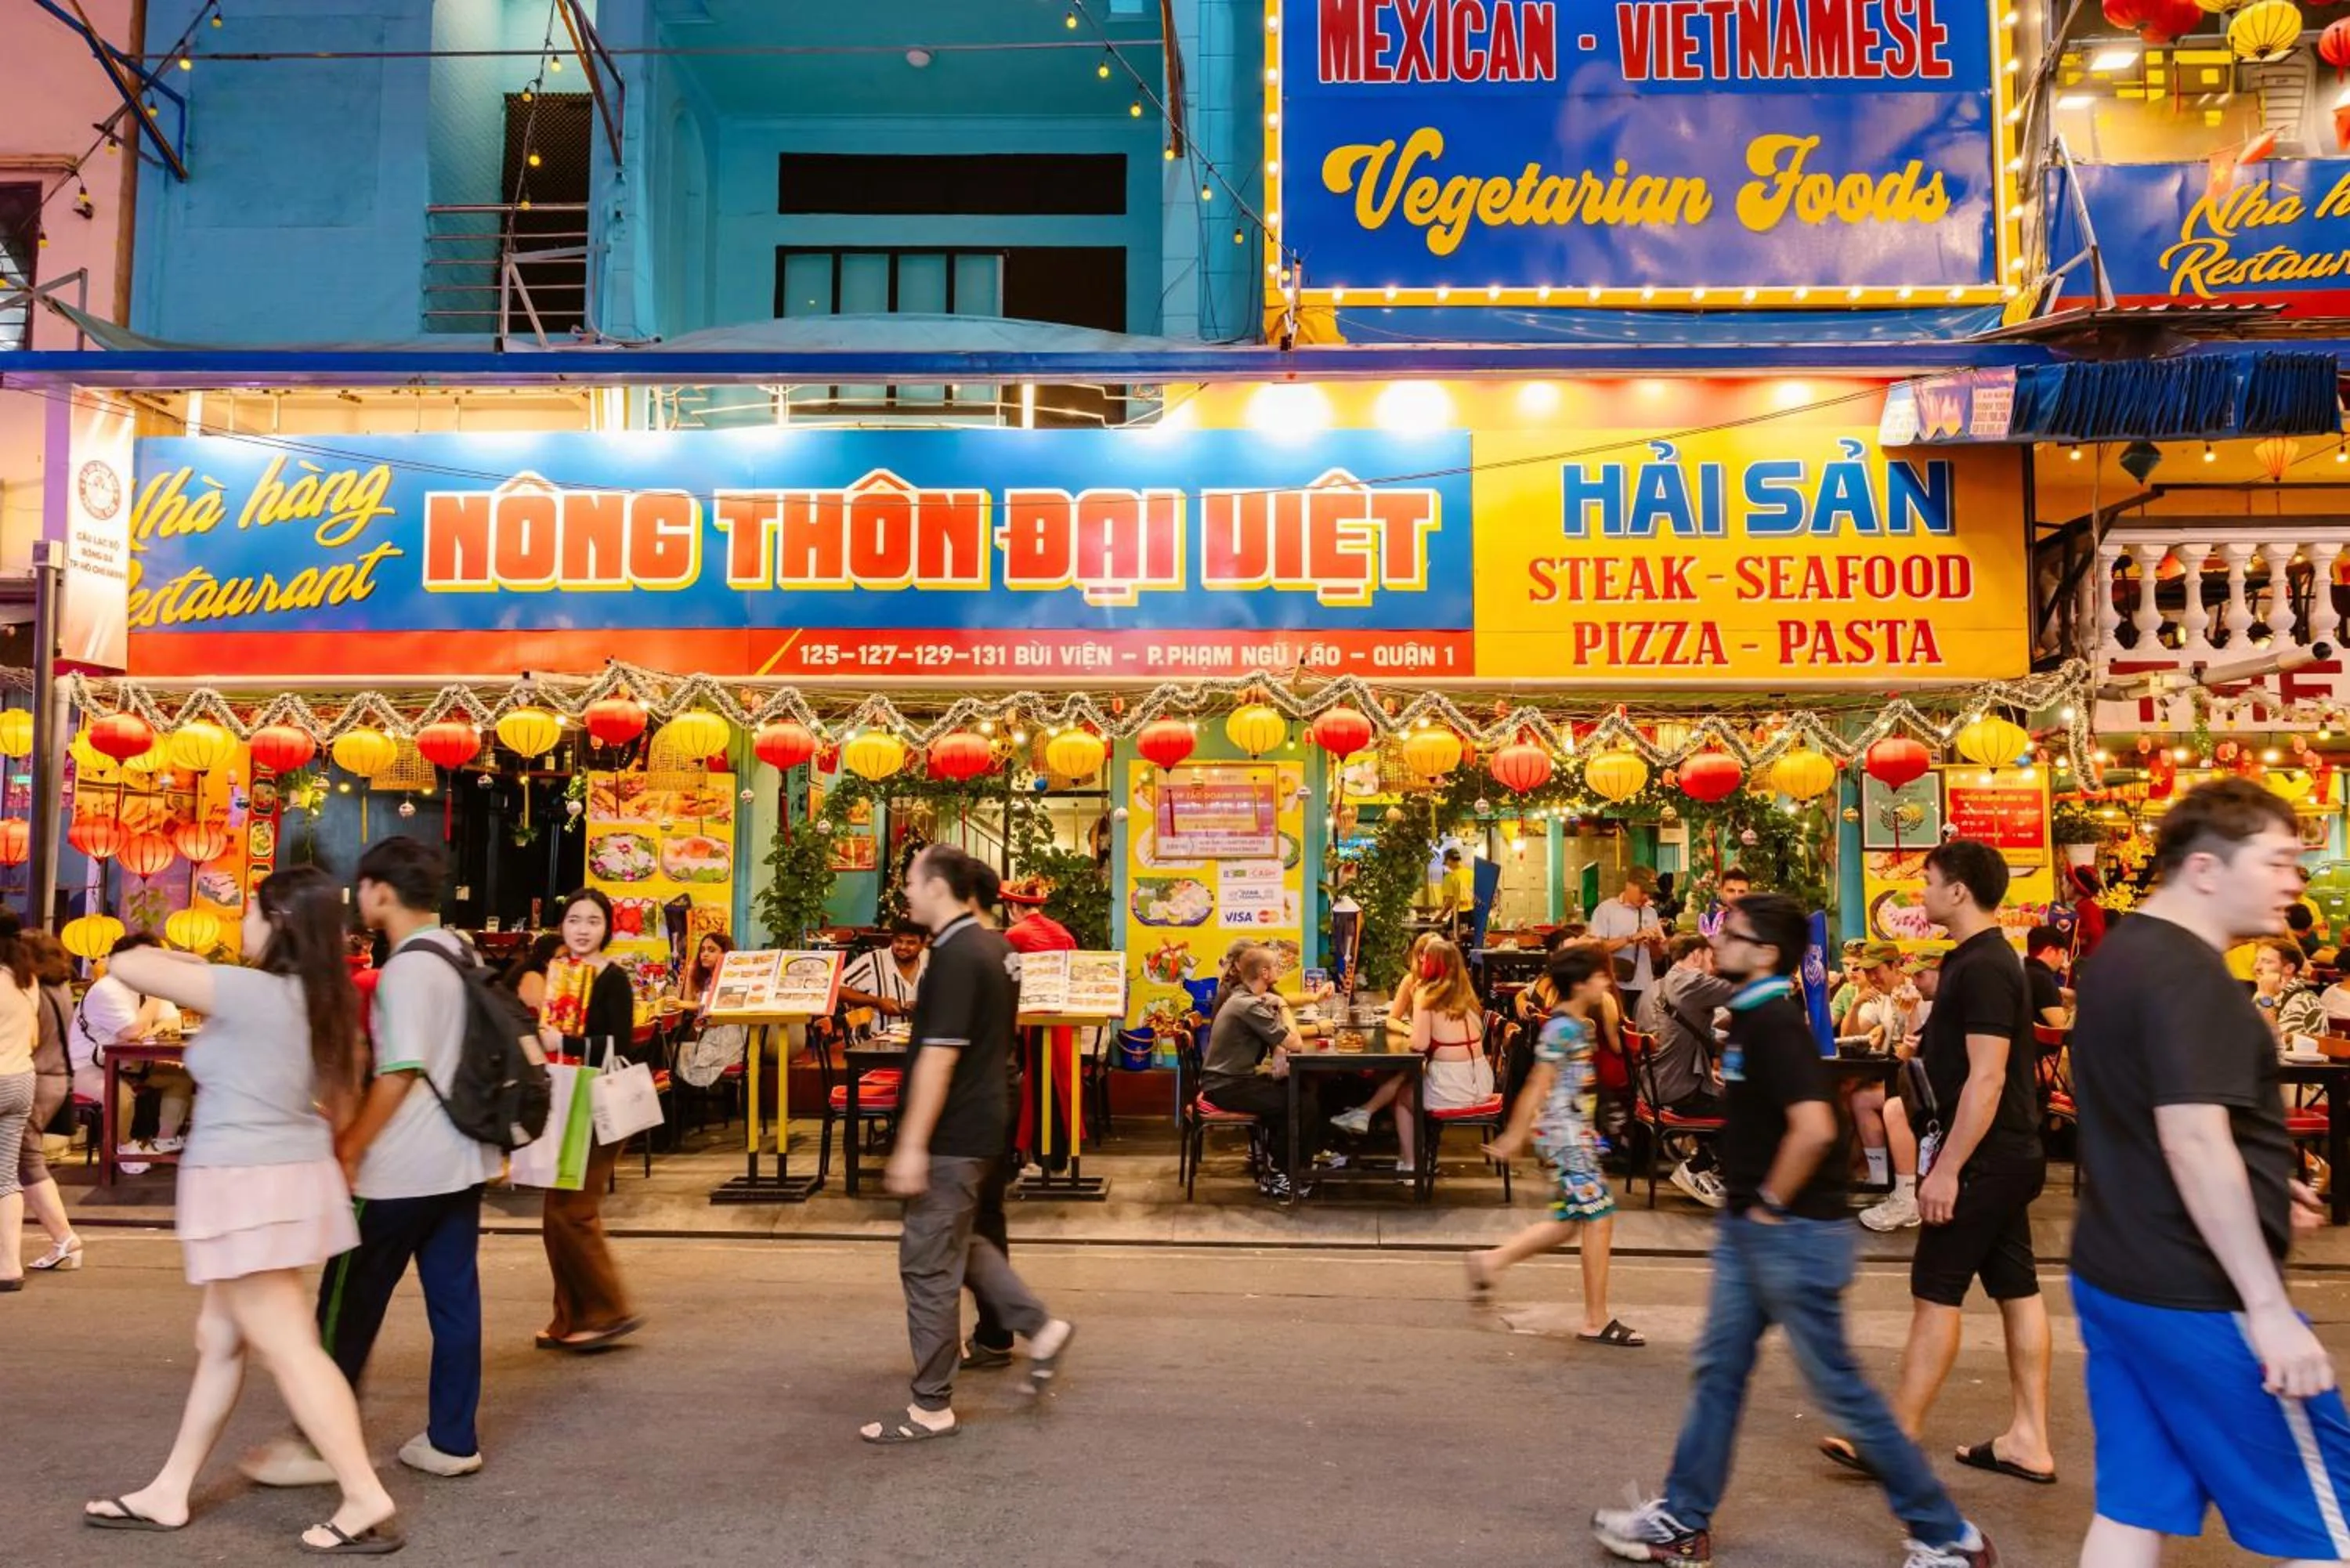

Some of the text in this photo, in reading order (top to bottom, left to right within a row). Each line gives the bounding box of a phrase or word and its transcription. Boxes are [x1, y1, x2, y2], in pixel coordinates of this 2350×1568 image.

[1318, 0, 1556, 83] MEXICAN
[1616, 0, 1953, 80] VIETNAMESE
[1321, 127, 1951, 257] Vegetarian Foods
[2181, 180, 2306, 242] Nhà
[237, 454, 396, 547] hàng
[1560, 438, 1957, 538] HẢI SẢN
[423, 468, 1441, 606] NÔNG THÔN ĐẠI VIỆT
[1528, 555, 1699, 603] STEAK
[1735, 553, 1974, 602] SEAFOOD
[1373, 641, 1437, 671] QUẬN
[1443, 645, 1455, 666] 1
[1572, 620, 1729, 667] PIZZA
[1778, 618, 1944, 665] PASTA
[1225, 912, 1253, 923] VISA
